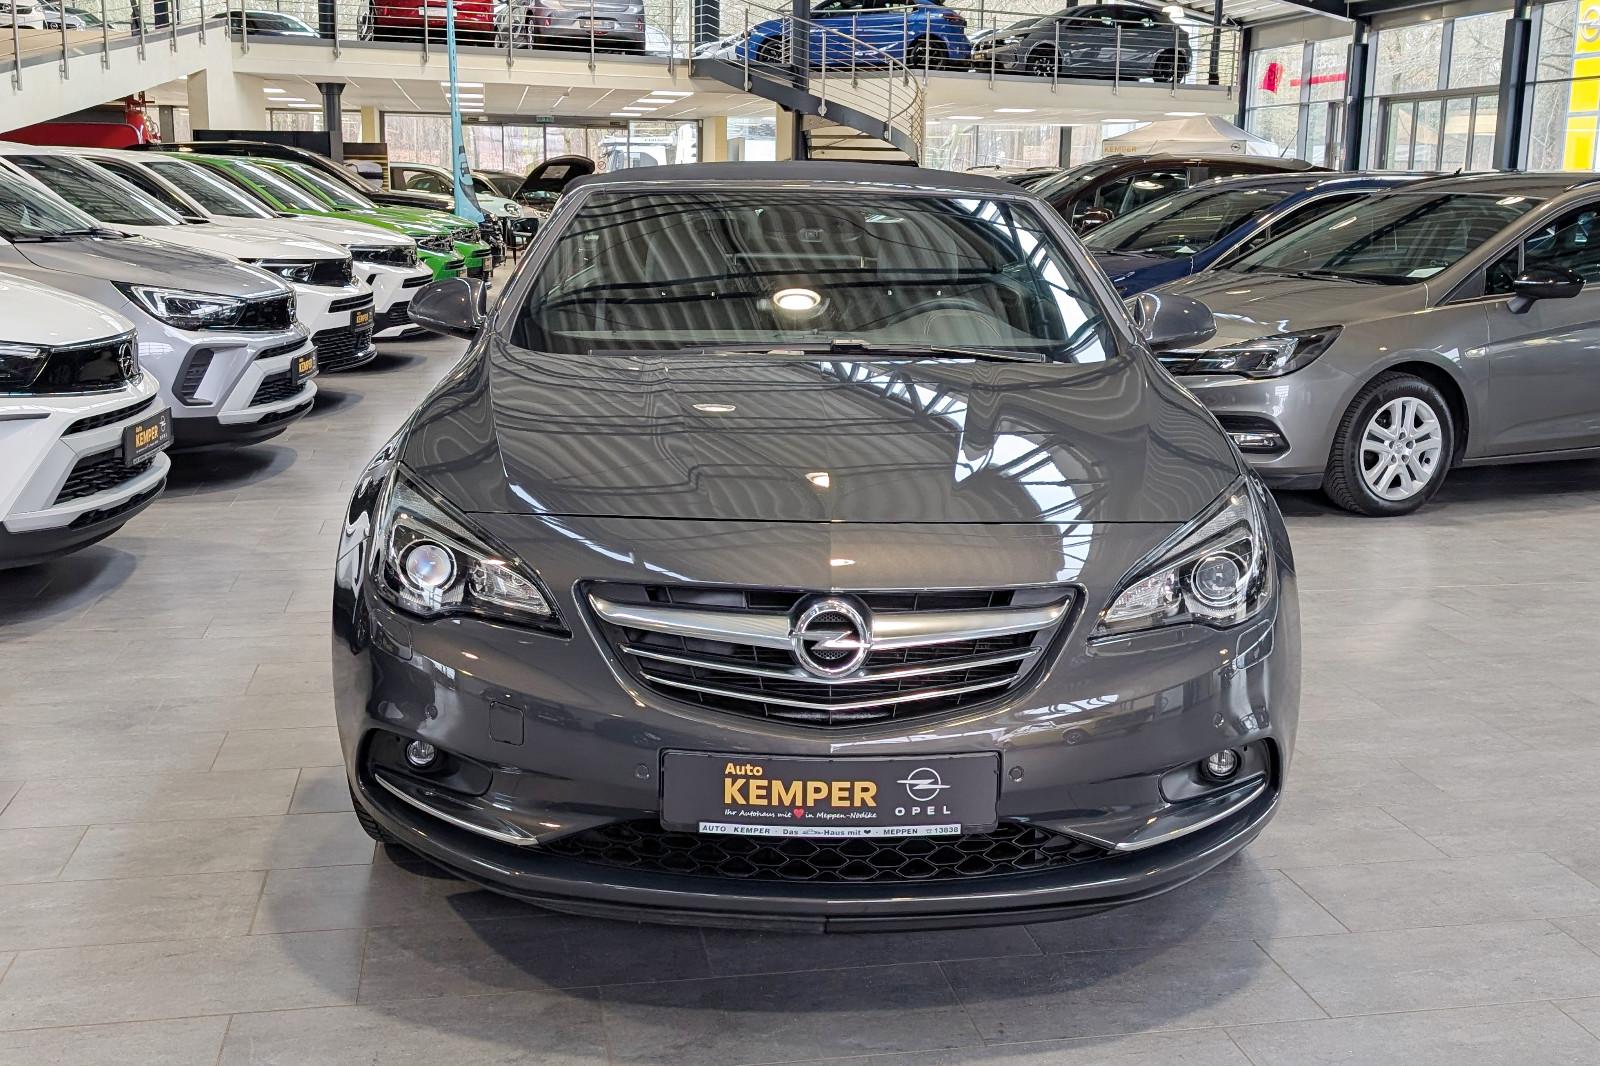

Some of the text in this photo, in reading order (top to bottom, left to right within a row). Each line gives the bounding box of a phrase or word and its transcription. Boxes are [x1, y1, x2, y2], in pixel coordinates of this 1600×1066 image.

[135, 425, 159, 448] KEMPER
[725, 762, 763, 776] Auto
[724, 778, 877, 807] KEMPER
[724, 808, 738, 816] Ihr
[739, 809, 775, 818] Autohaus
[777, 810, 793, 818] mit
[895, 805, 951, 816] OPEL
[702, 825, 727, 833] AUTO
[733, 826, 771, 834] KEMPER
[934, 826, 959, 834] 13838
